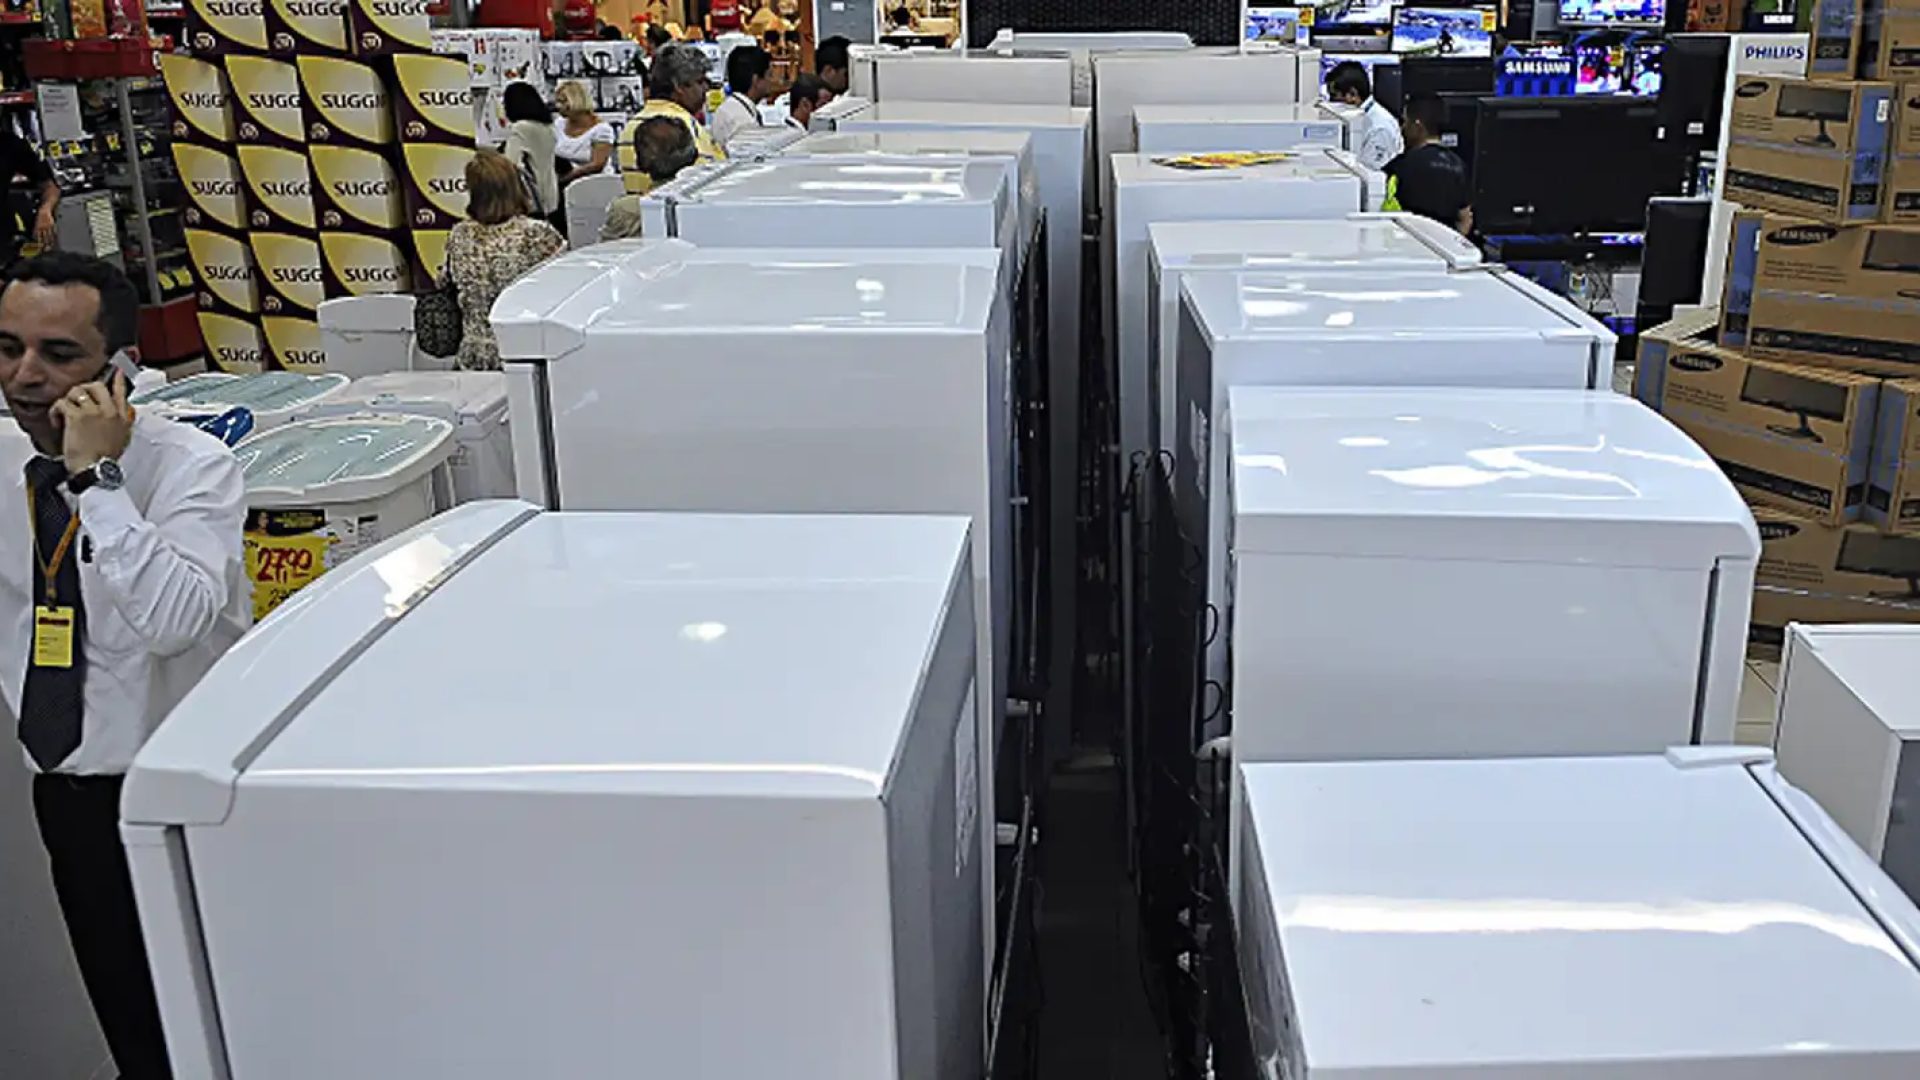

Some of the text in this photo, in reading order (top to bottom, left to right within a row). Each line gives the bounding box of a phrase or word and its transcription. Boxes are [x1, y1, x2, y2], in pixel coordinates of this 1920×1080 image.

[1745, 46, 1804, 59] PHILIPS
[1505, 61, 1570, 75] SAMSUNG
[344, 266, 404, 281] SUGG
